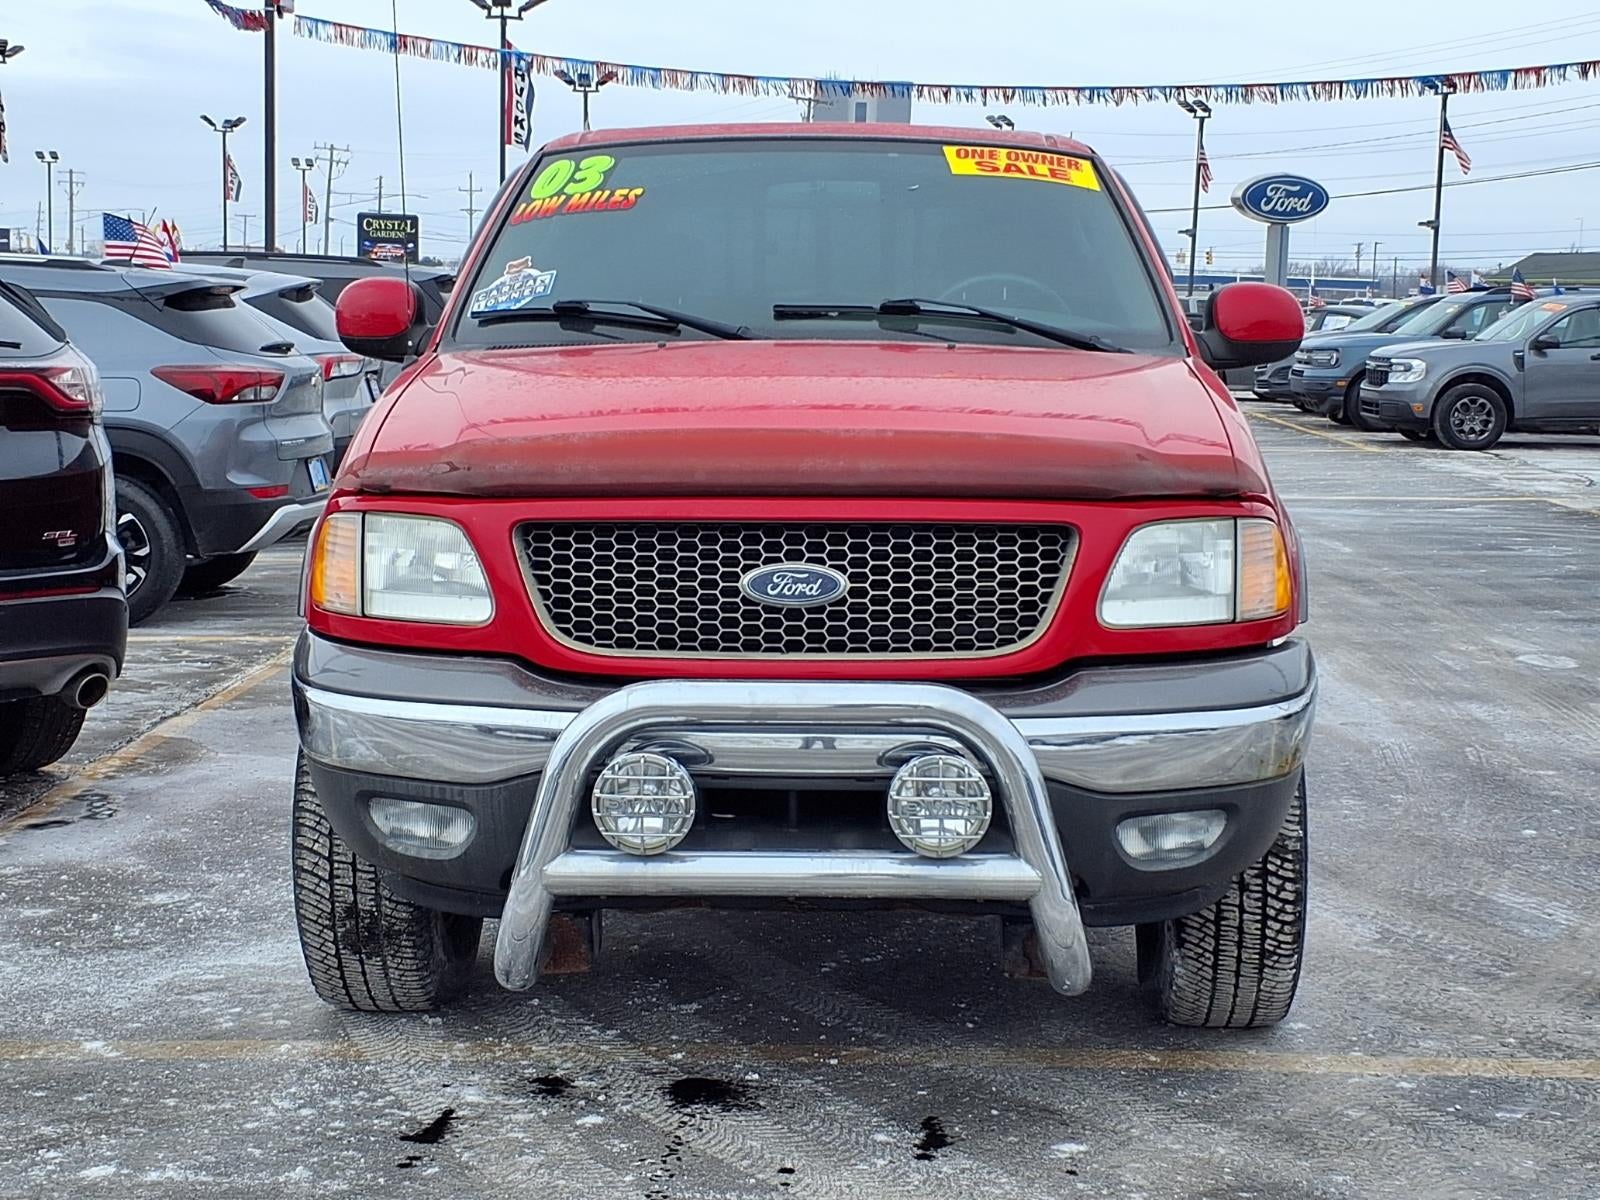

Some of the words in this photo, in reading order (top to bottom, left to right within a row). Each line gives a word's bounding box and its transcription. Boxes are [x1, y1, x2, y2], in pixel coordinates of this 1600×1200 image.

[955, 148, 1000, 161] ONE
[1006, 151, 1082, 171] OWNER
[530, 155, 615, 199] 03
[975, 161, 1072, 182] SALE
[511, 194, 567, 225] LOW
[563, 187, 644, 214] MILES
[1260, 184, 1314, 212] Ford
[363, 218, 416, 233] CRYSTAL
[487, 285, 546, 306] OWNER
[766, 572, 823, 595] Ford
